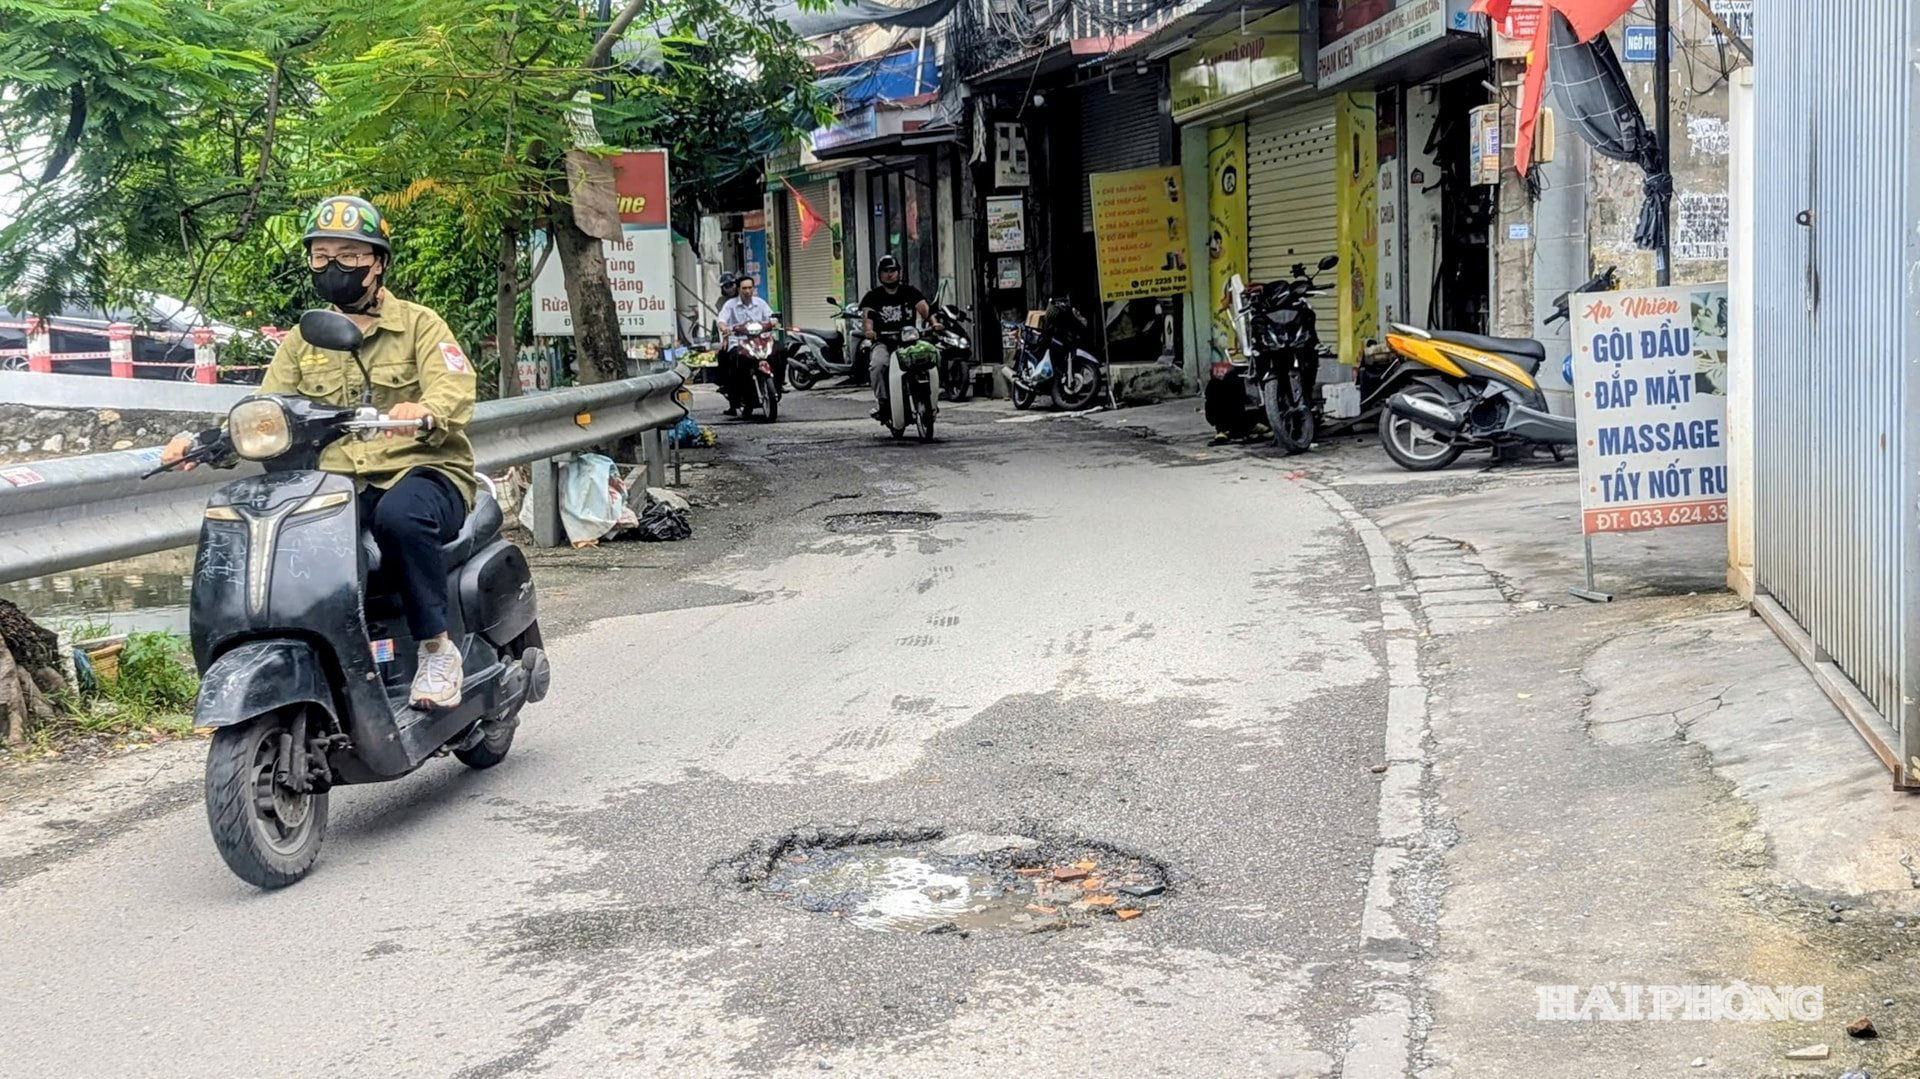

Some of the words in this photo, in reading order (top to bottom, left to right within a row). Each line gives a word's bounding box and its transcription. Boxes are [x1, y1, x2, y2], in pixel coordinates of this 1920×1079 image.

[1734, 2, 1751, 10] VAY
[638, 295, 666, 312] Dầu
[1619, 296, 1680, 319] Nhiên
[1593, 327, 1632, 367] GỘI
[1639, 318, 1690, 358] ĐẦU
[1595, 370, 1638, 410] ĐẮP
[1645, 369, 1691, 410] MẶT
[1598, 419, 1720, 457] MASSAGE
[1600, 461, 1641, 503] TẨY
[1649, 458, 1692, 499] NỐT
[1700, 465, 1728, 495] RU
[1596, 512, 1625, 530] ĐT:
[1630, 505, 1728, 528] 033.624.33
